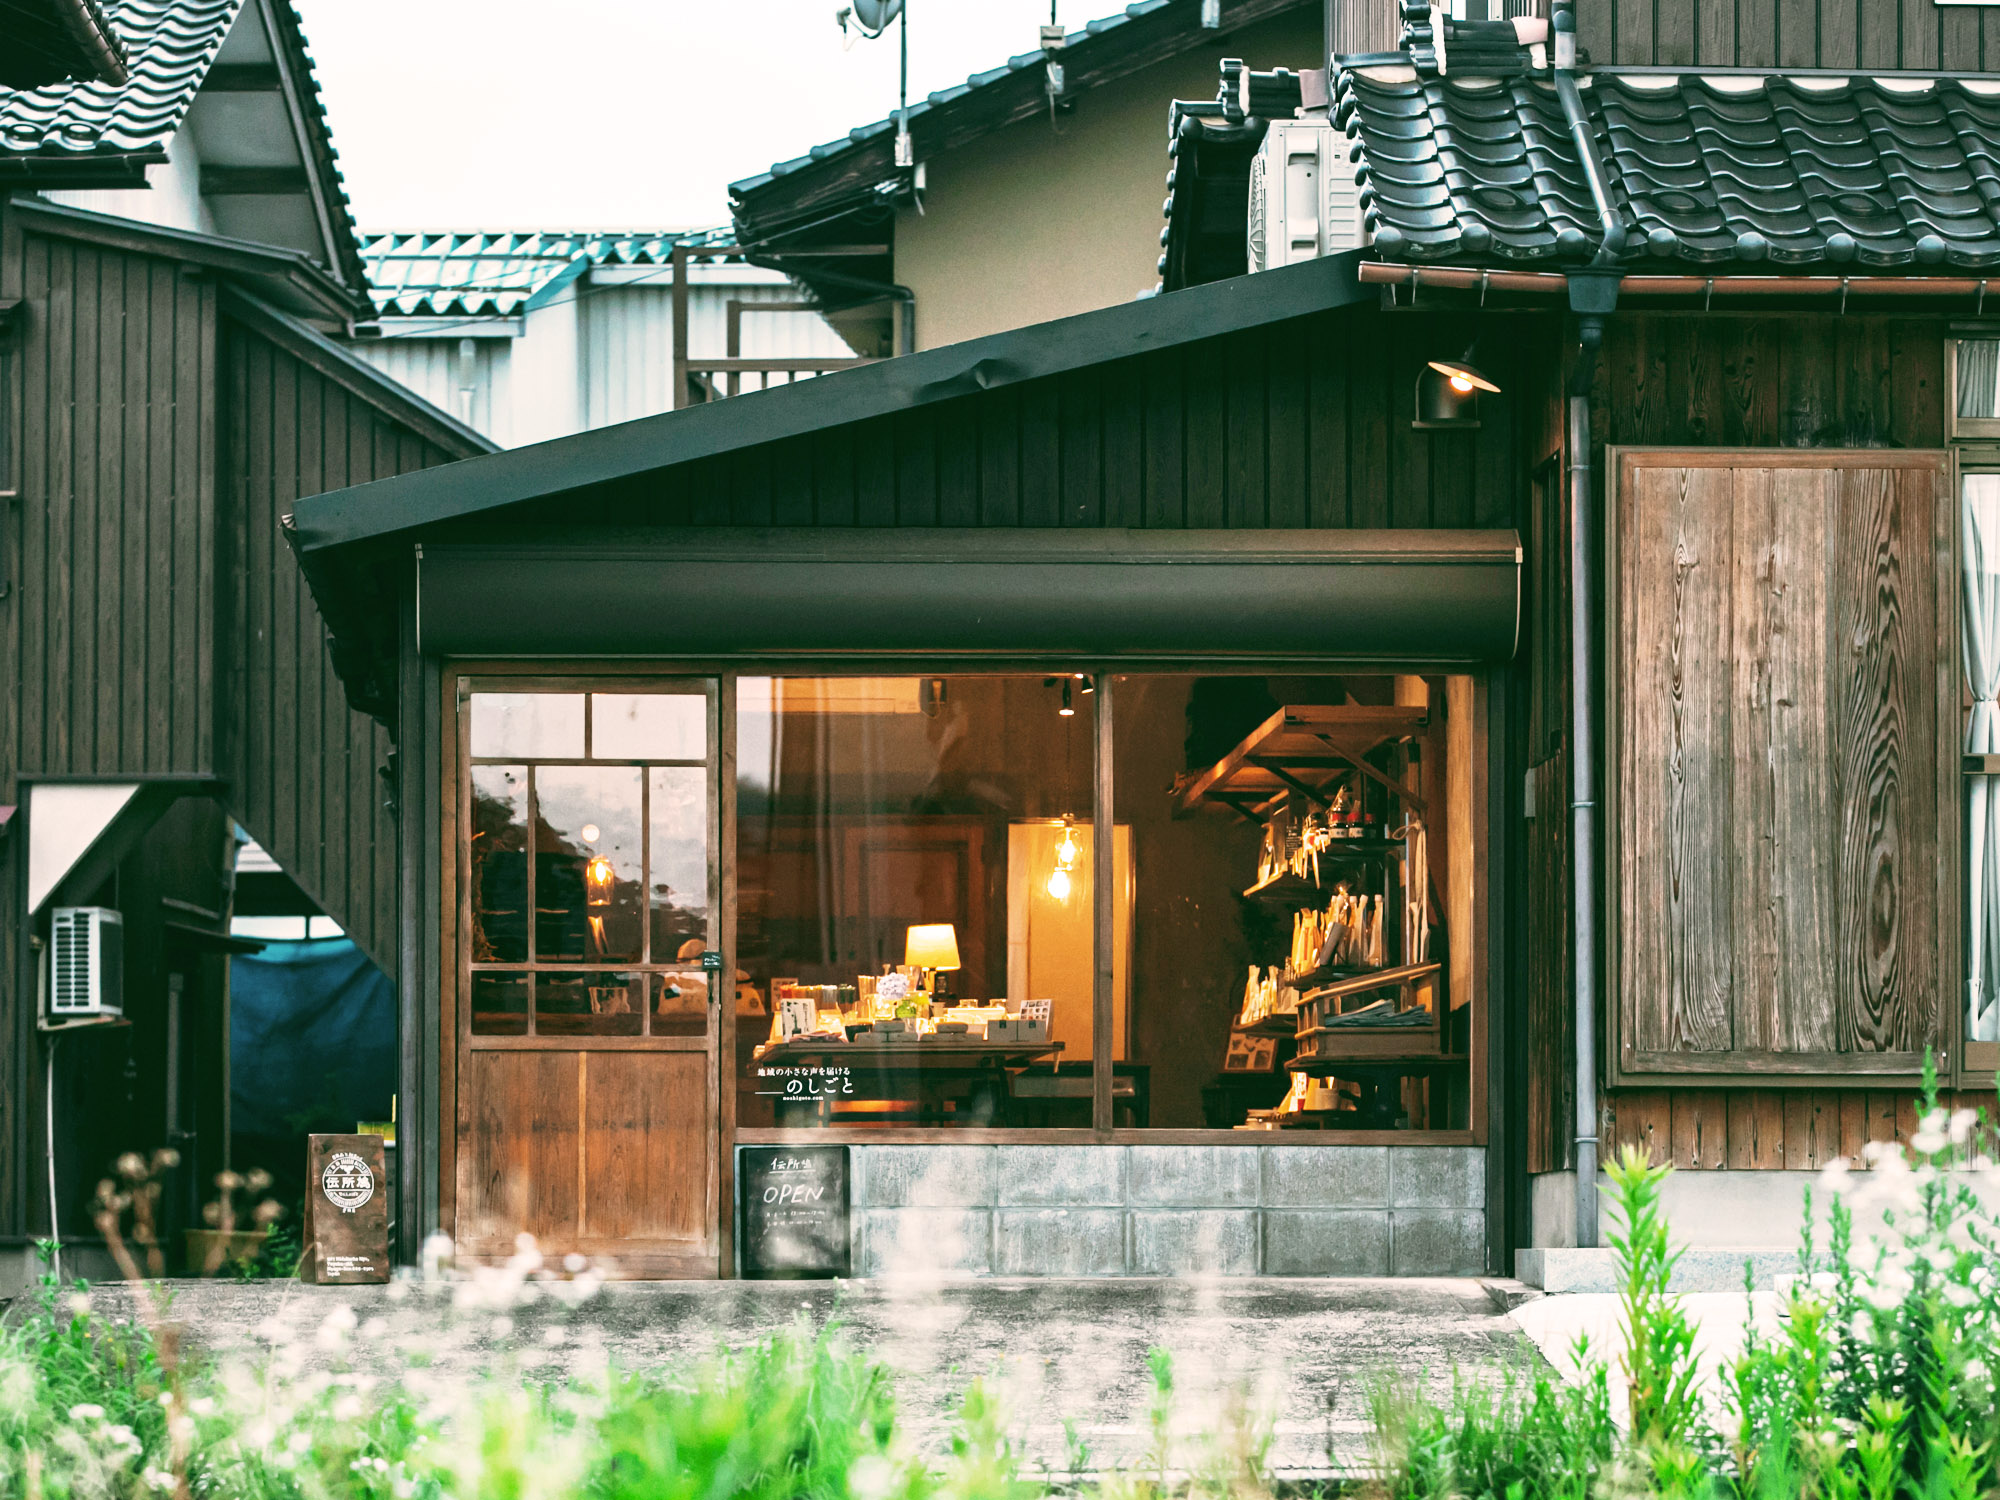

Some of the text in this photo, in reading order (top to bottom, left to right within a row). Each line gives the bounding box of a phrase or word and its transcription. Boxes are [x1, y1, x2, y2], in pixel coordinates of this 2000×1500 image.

[786, 1076, 854, 1095] のしごと
[763, 1183, 825, 1206] OPEN
